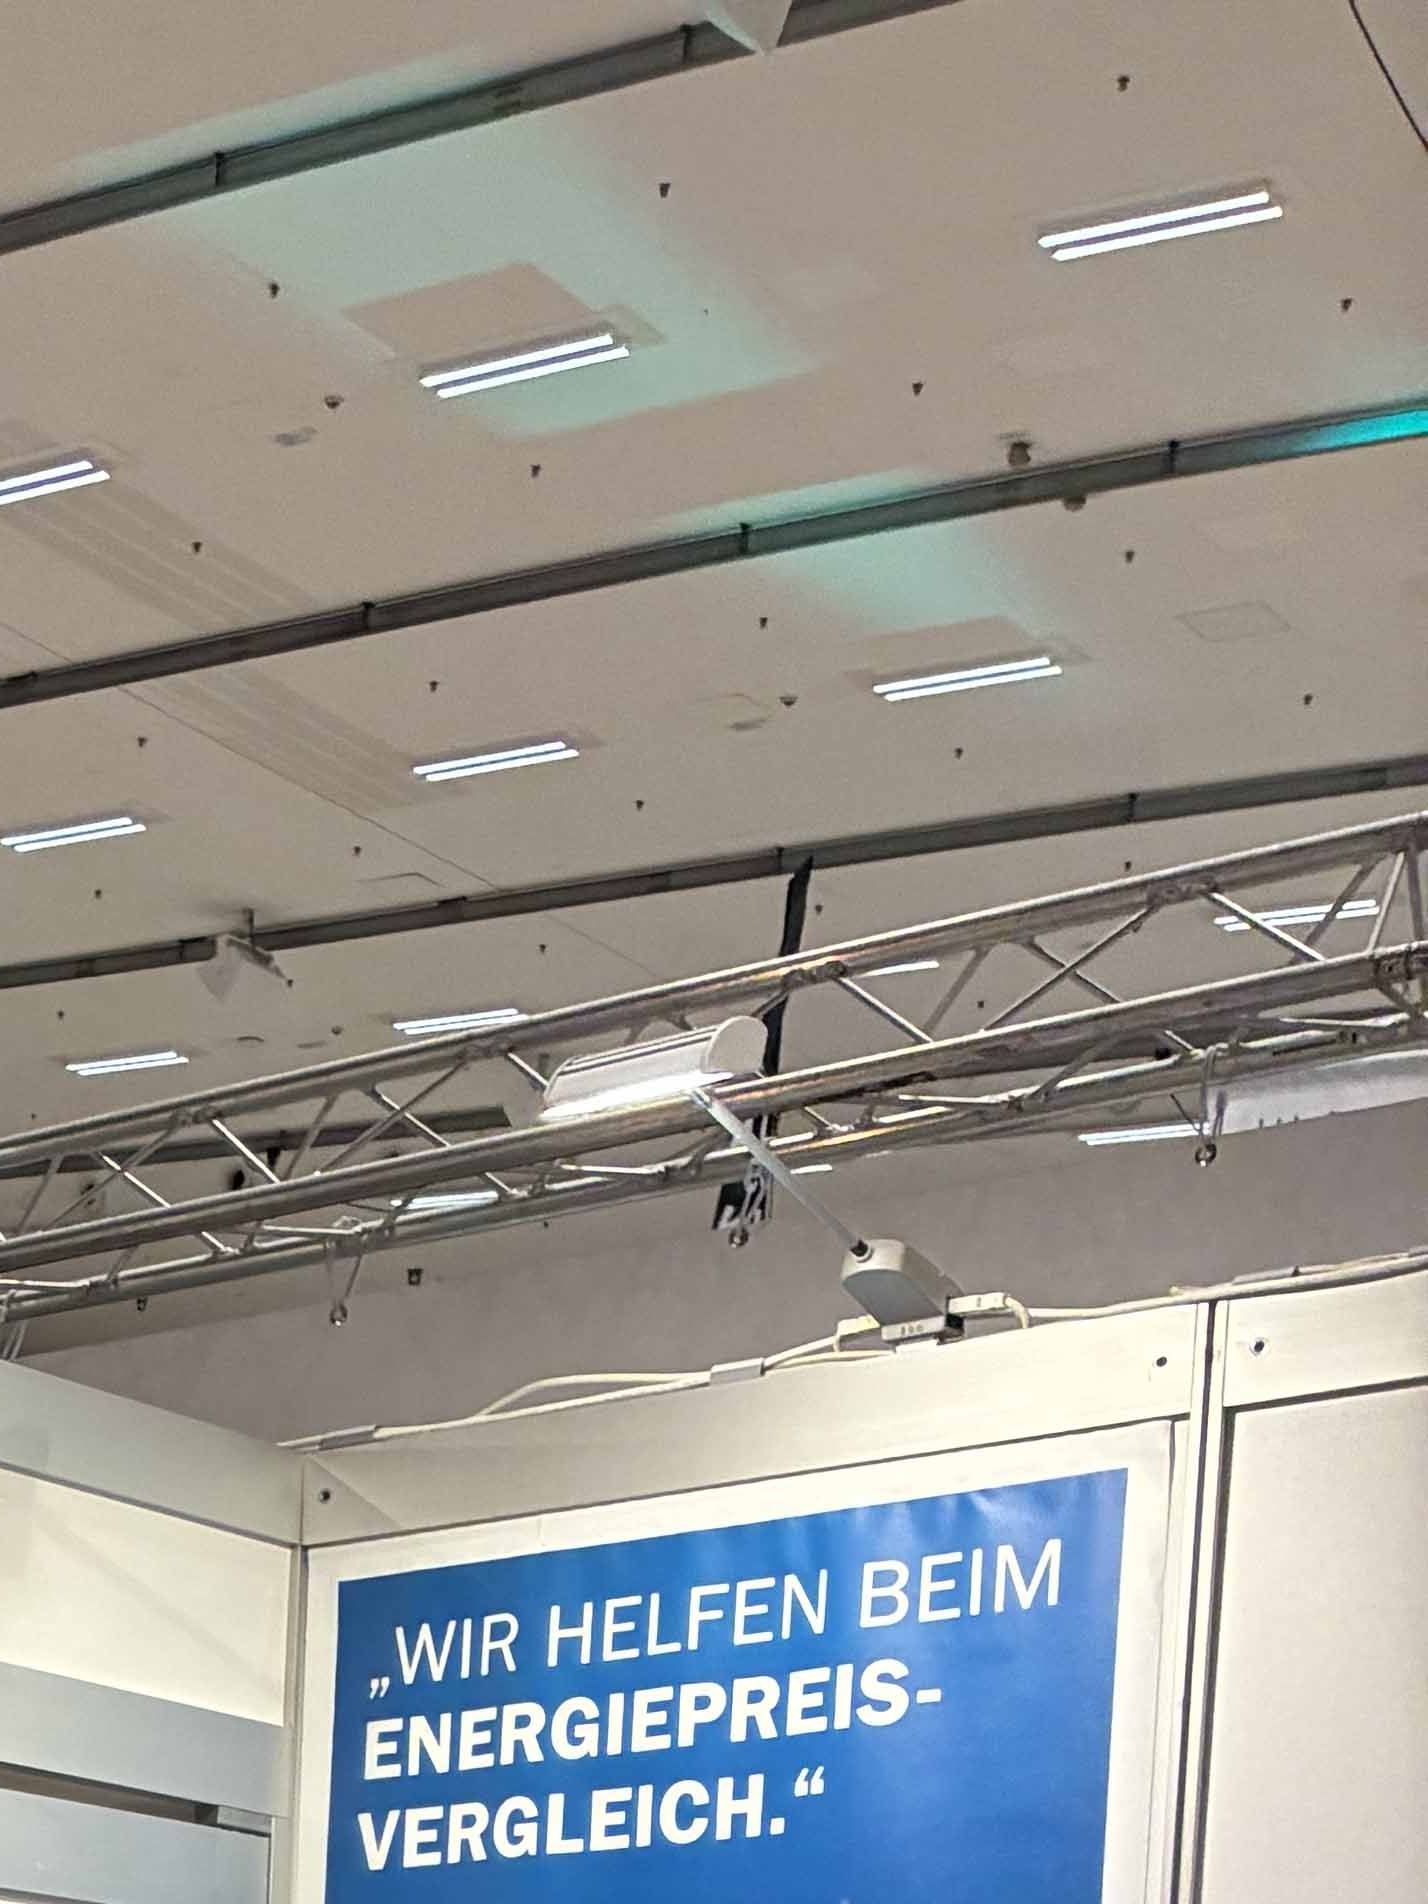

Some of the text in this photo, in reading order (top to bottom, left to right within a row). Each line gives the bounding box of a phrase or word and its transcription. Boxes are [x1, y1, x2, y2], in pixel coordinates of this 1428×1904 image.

[368, 1537, 1062, 1699] „WIR HELFEN BEIM
[363, 1658, 942, 1781] ENERGIEPREIS-
[357, 1766, 826, 1871] VERGLEICH.“
